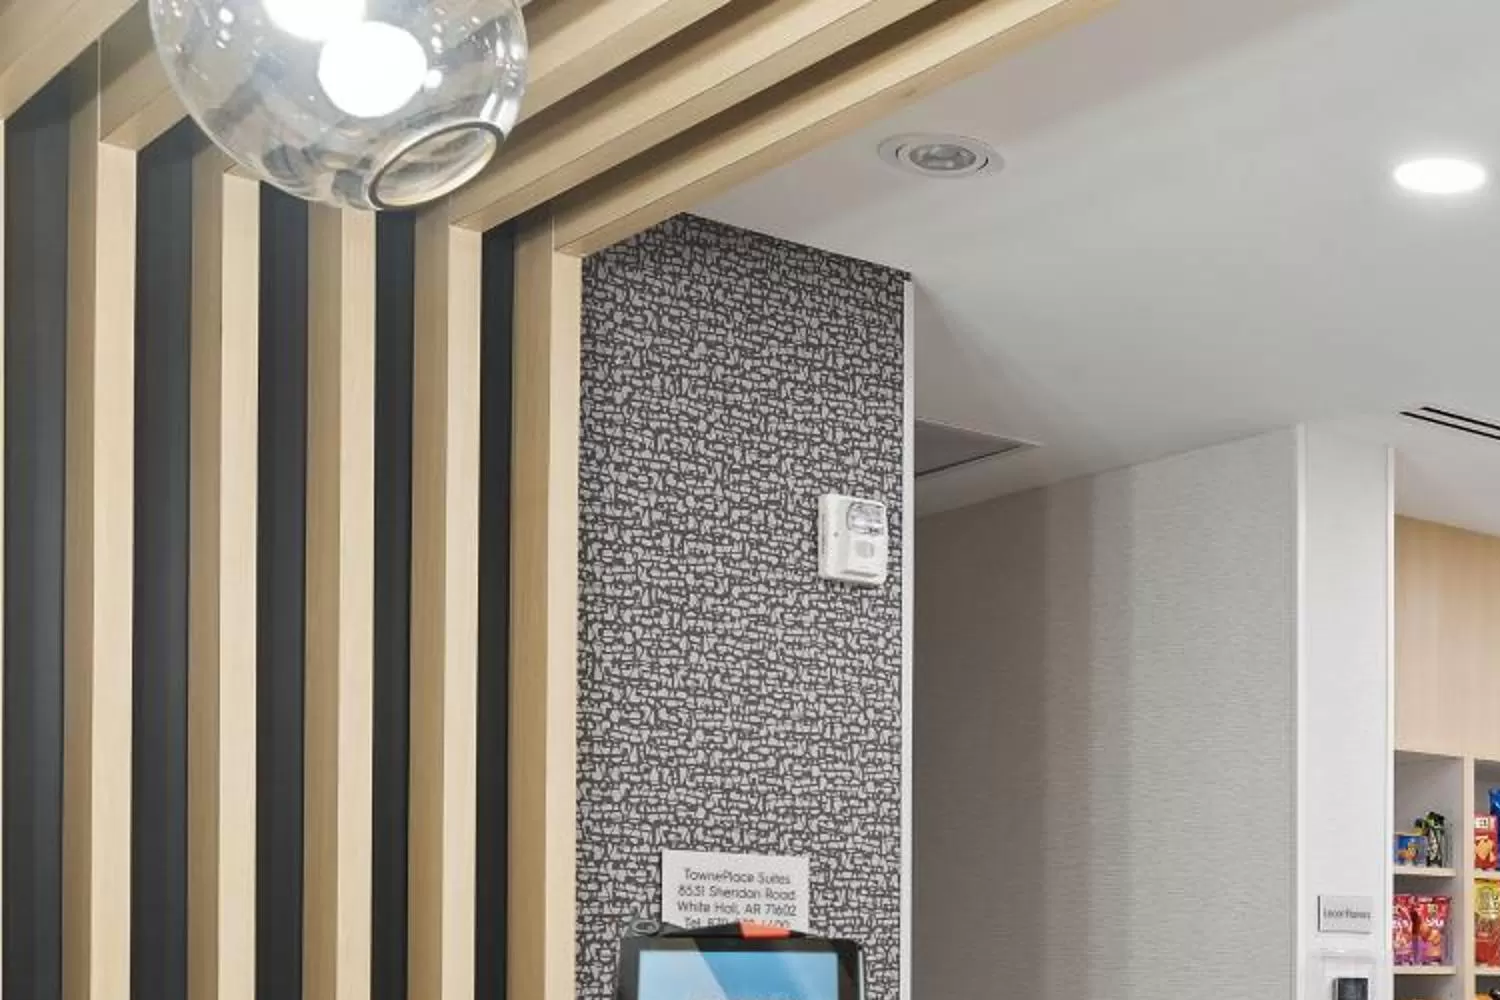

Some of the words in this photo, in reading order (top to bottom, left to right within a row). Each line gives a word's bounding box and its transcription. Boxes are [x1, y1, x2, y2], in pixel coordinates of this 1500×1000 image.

[684, 867, 755, 883] TownePlace
[757, 871, 791, 885] Suites
[708, 885, 761, 900] Sheridan
[765, 887, 797, 901] Road
[676, 900, 711, 913] White
[745, 903, 761, 915] AR
[764, 903, 797, 917] 71602
